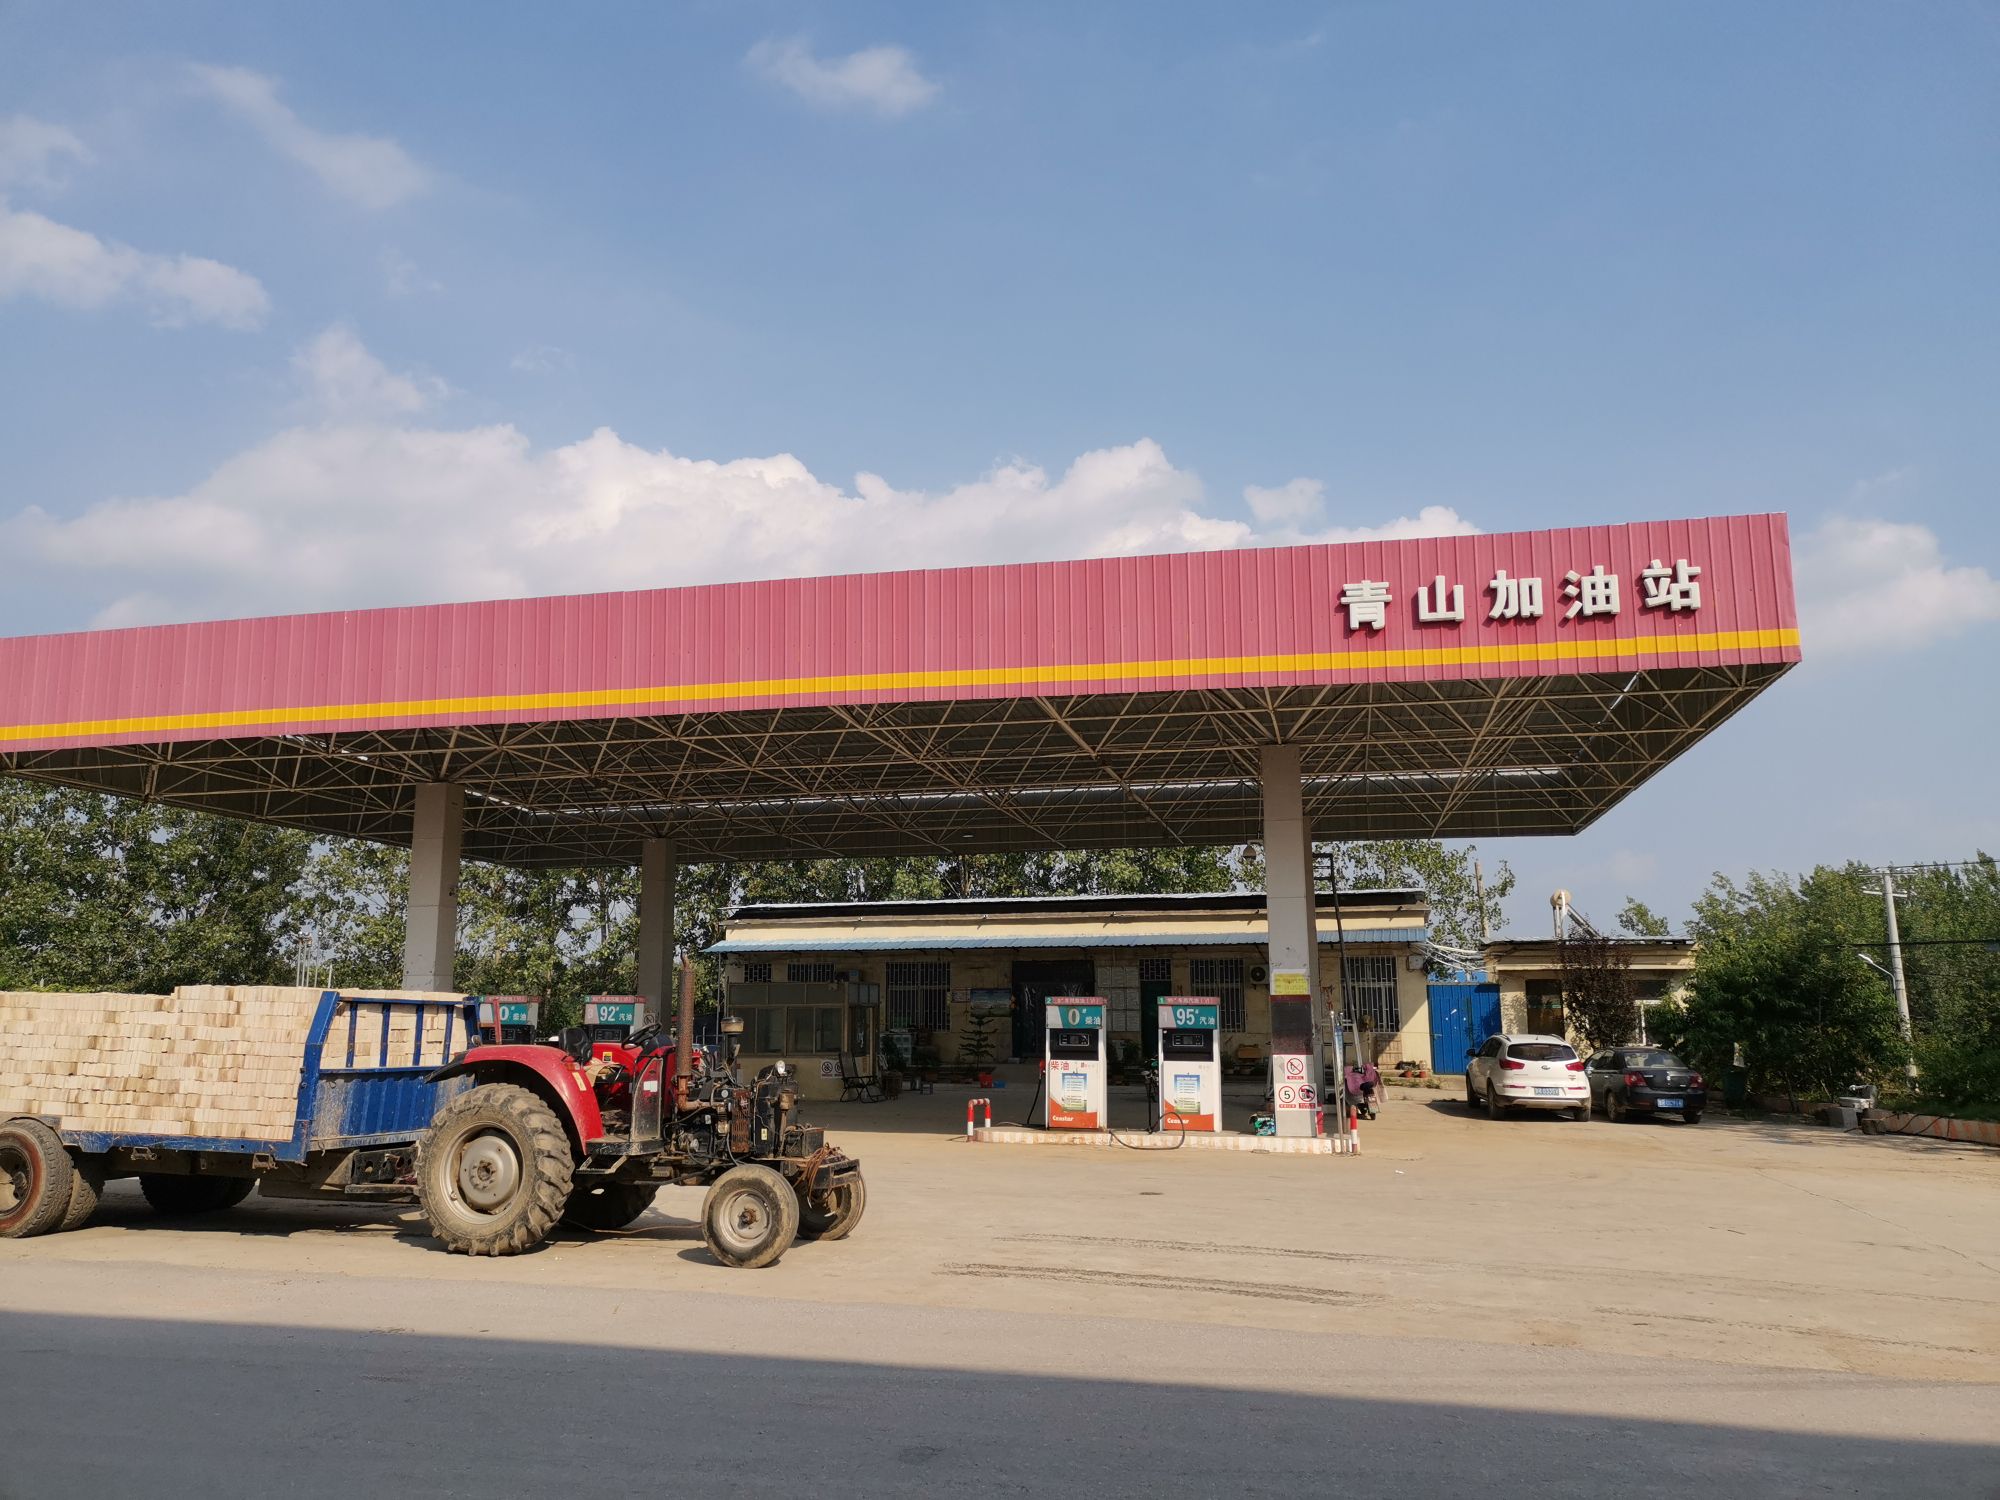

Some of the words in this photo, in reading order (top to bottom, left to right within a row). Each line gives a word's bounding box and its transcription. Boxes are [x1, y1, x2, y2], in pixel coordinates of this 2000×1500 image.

[1340, 558, 1702, 631] 青山加油站
[1199, 1016, 1216, 1025] 汽油
[1284, 1090, 1291, 1100] 5
